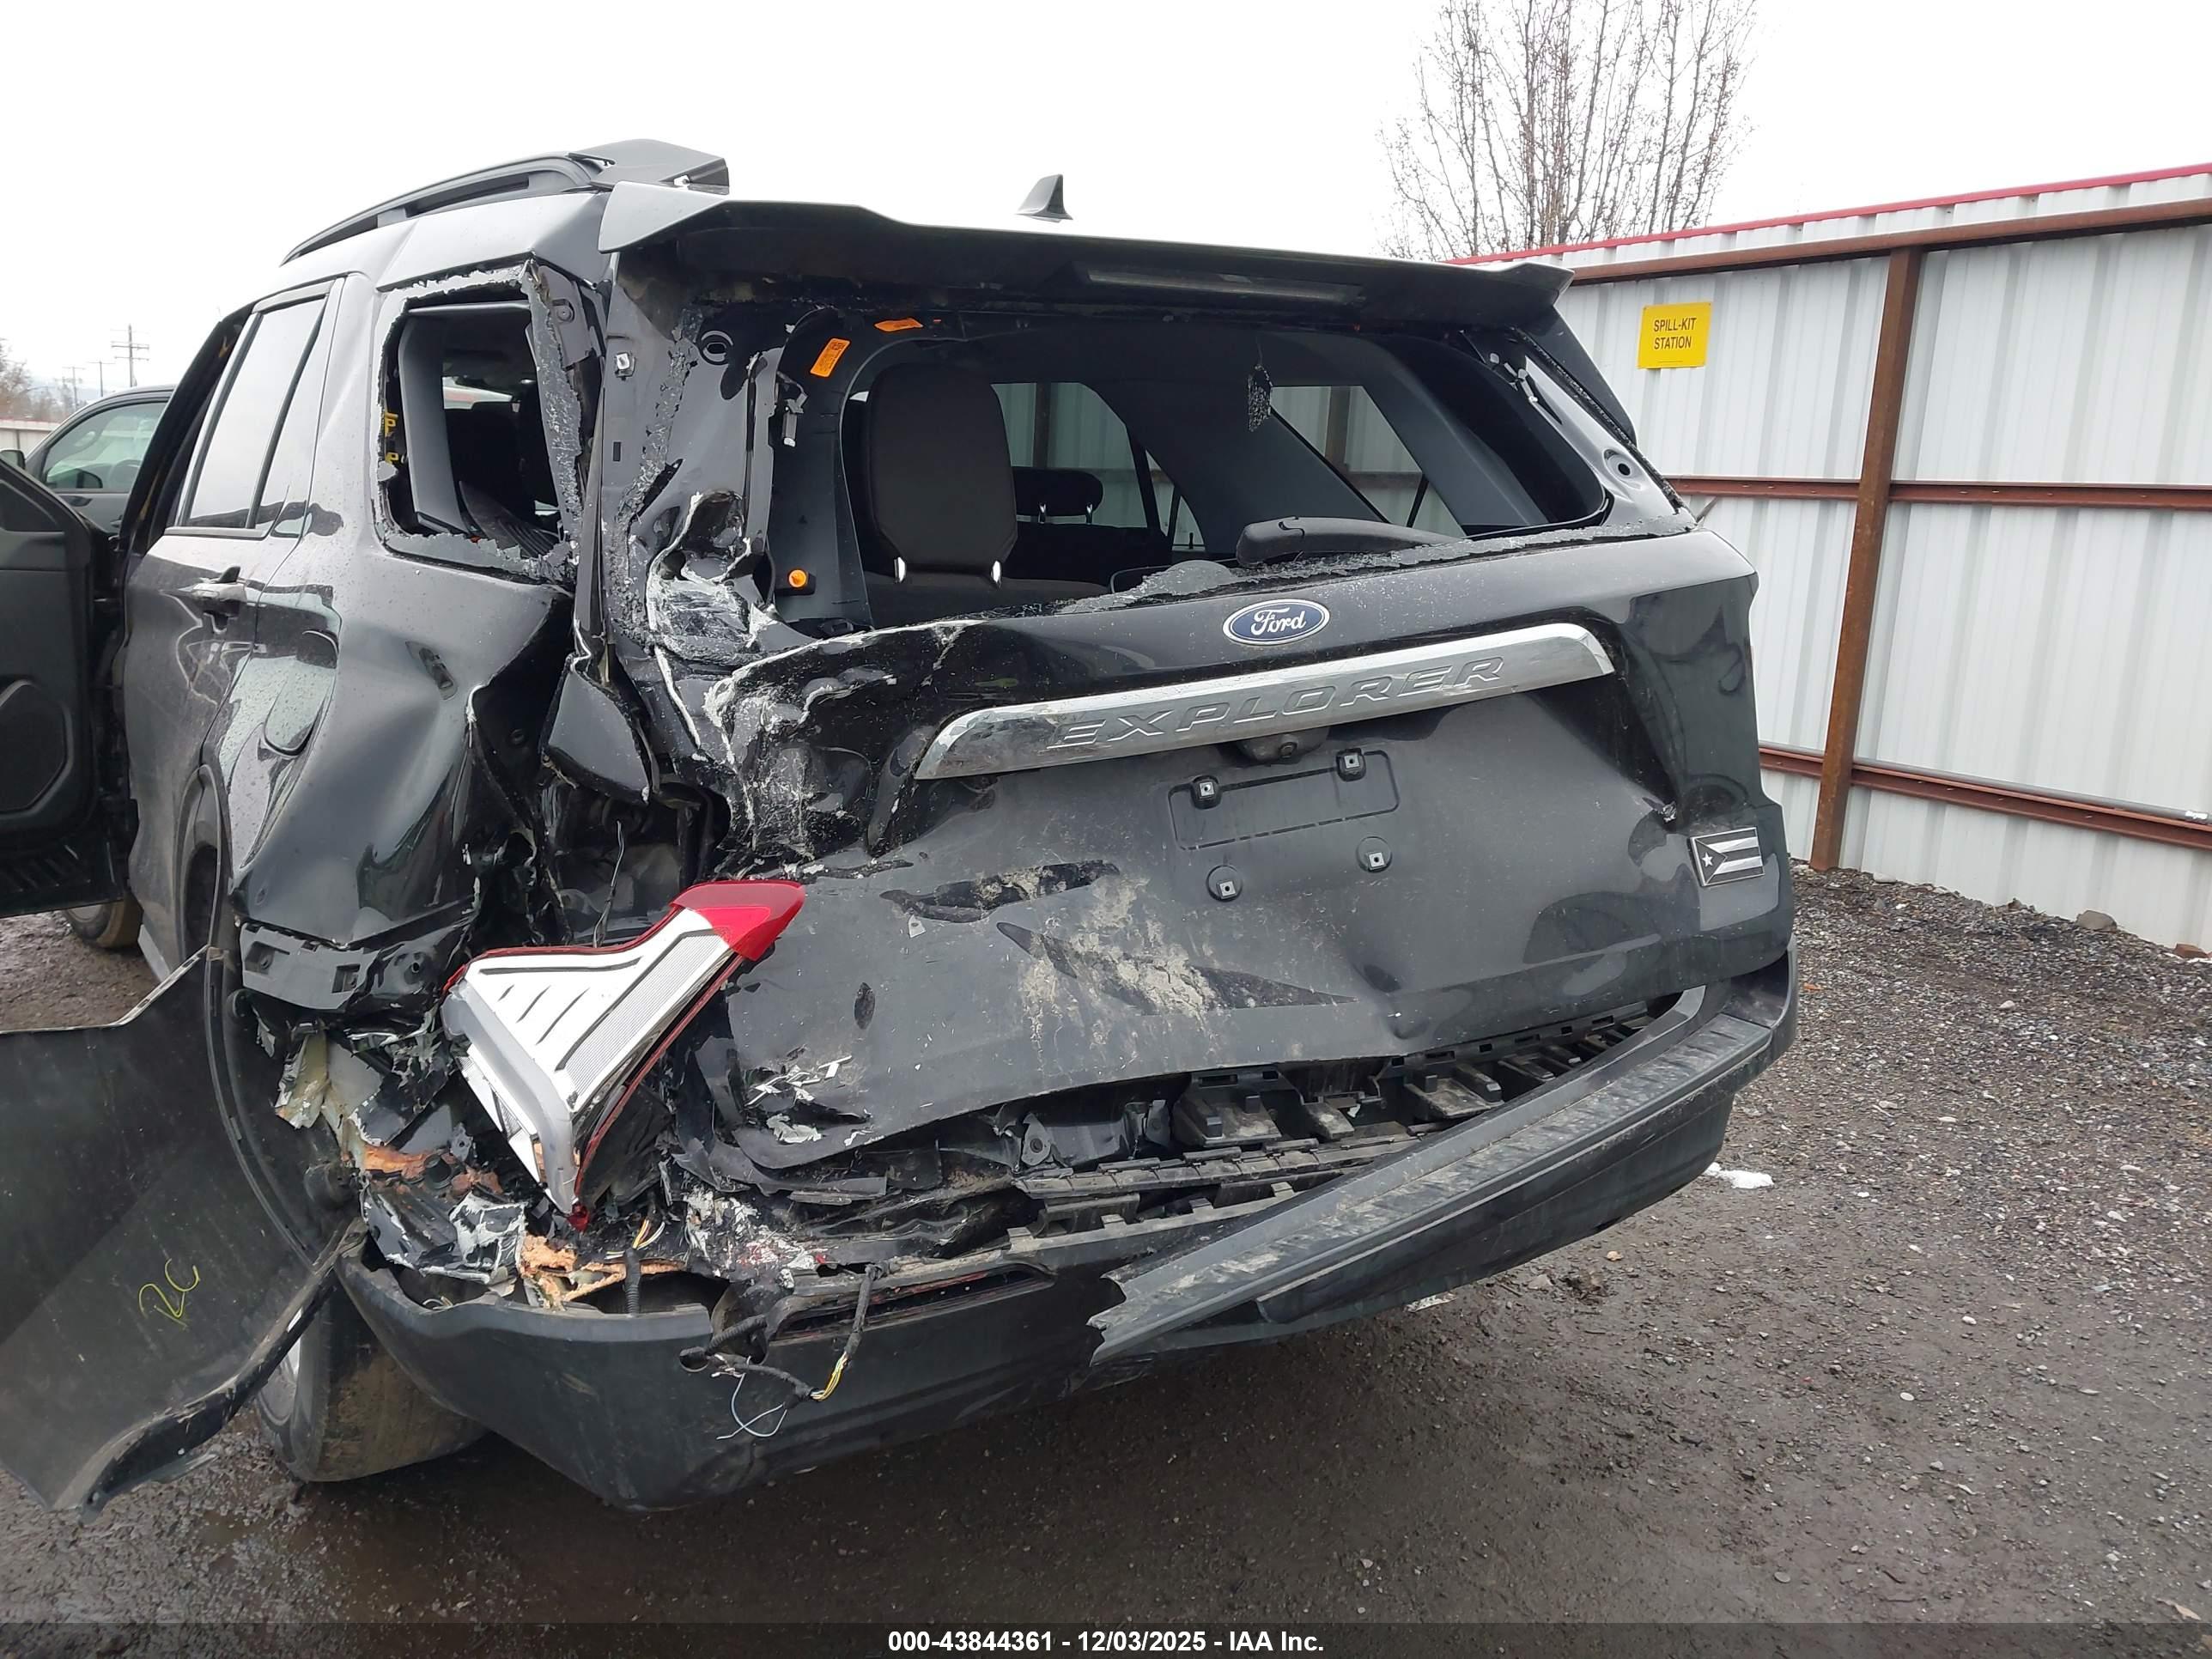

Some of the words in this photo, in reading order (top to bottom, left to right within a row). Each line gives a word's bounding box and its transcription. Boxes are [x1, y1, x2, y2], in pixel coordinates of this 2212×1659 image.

[1653, 317, 1697, 332] SPILL-KIT
[1654, 336, 1692, 349] STATION
[1251, 607, 1306, 635] Ford
[1046, 656, 1504, 749] EXPLORER
